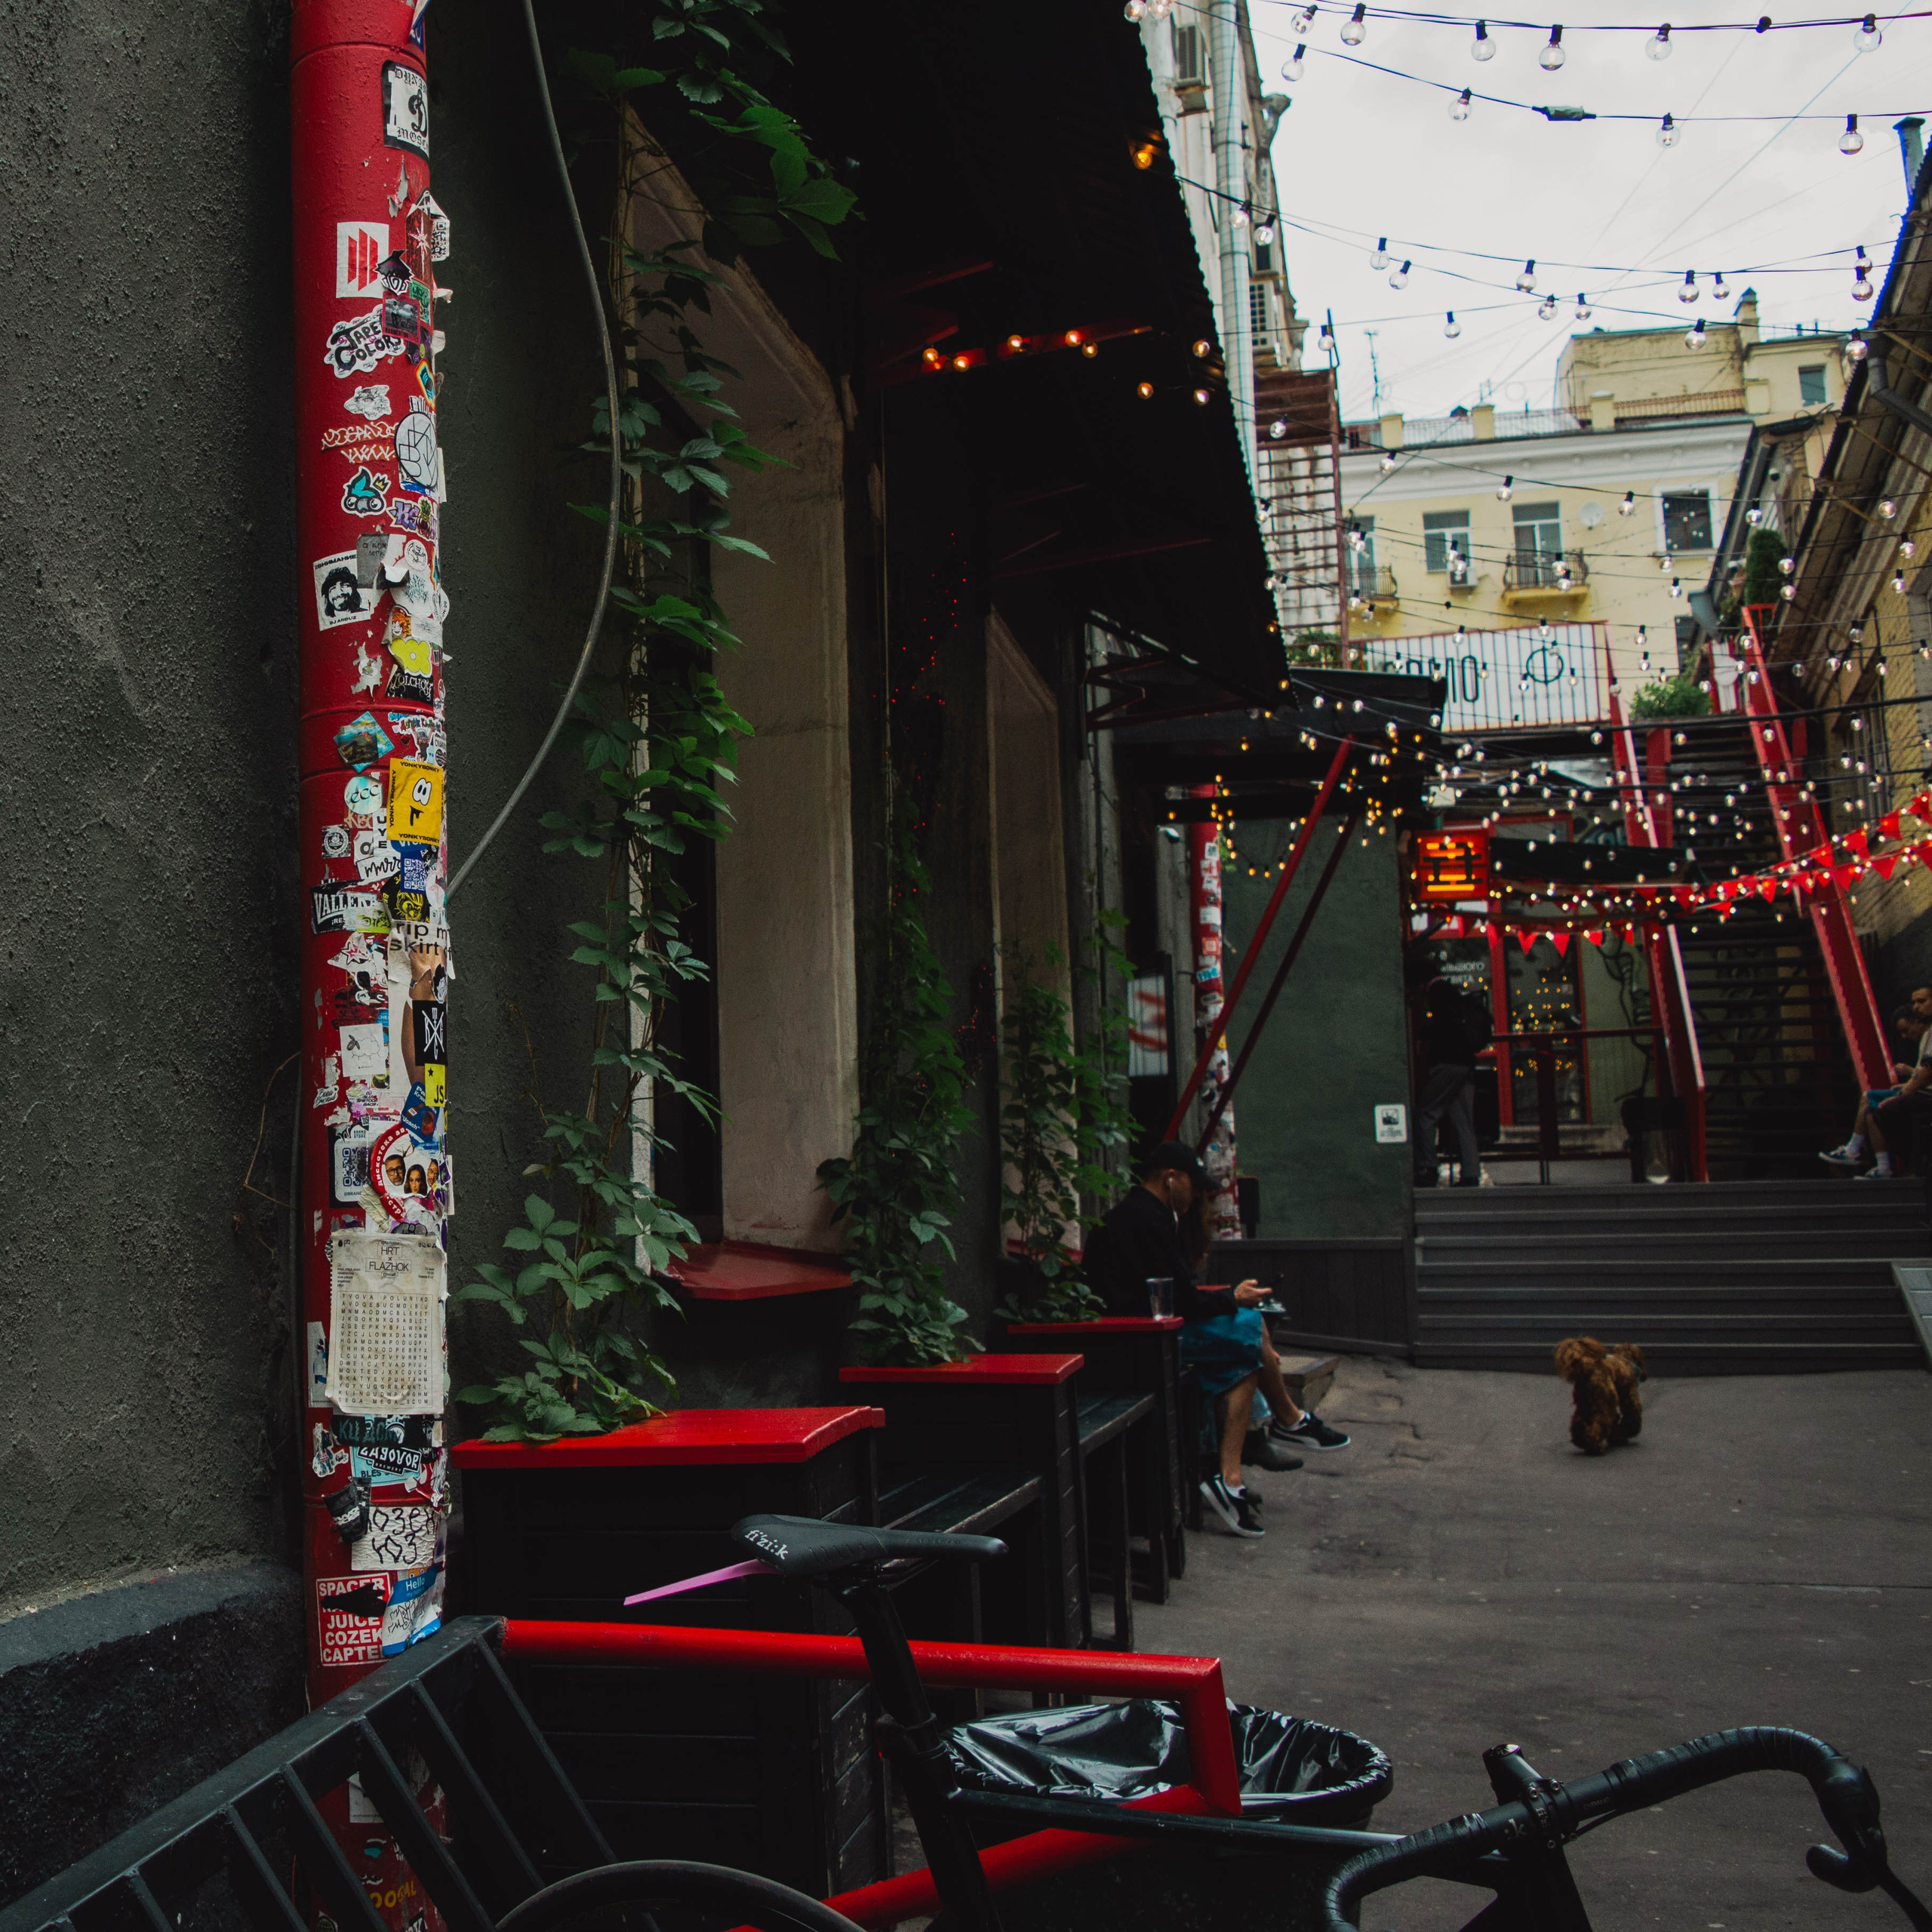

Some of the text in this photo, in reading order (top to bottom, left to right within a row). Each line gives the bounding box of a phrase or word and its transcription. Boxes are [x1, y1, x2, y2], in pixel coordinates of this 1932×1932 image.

[396, 922, 429, 940] rip
[389, 940, 439, 955] skirt
[434, 1085, 444, 1104] JS
[381, 1247, 399, 1255] HRT
[369, 1262, 409, 1272] FLAZHOK
[376, 1463, 402, 1472] BREWERY
[405, 1577, 425, 1592] Hello
[327, 1614, 380, 1629] JUICE
[323, 1644, 383, 1663] CAPTE
